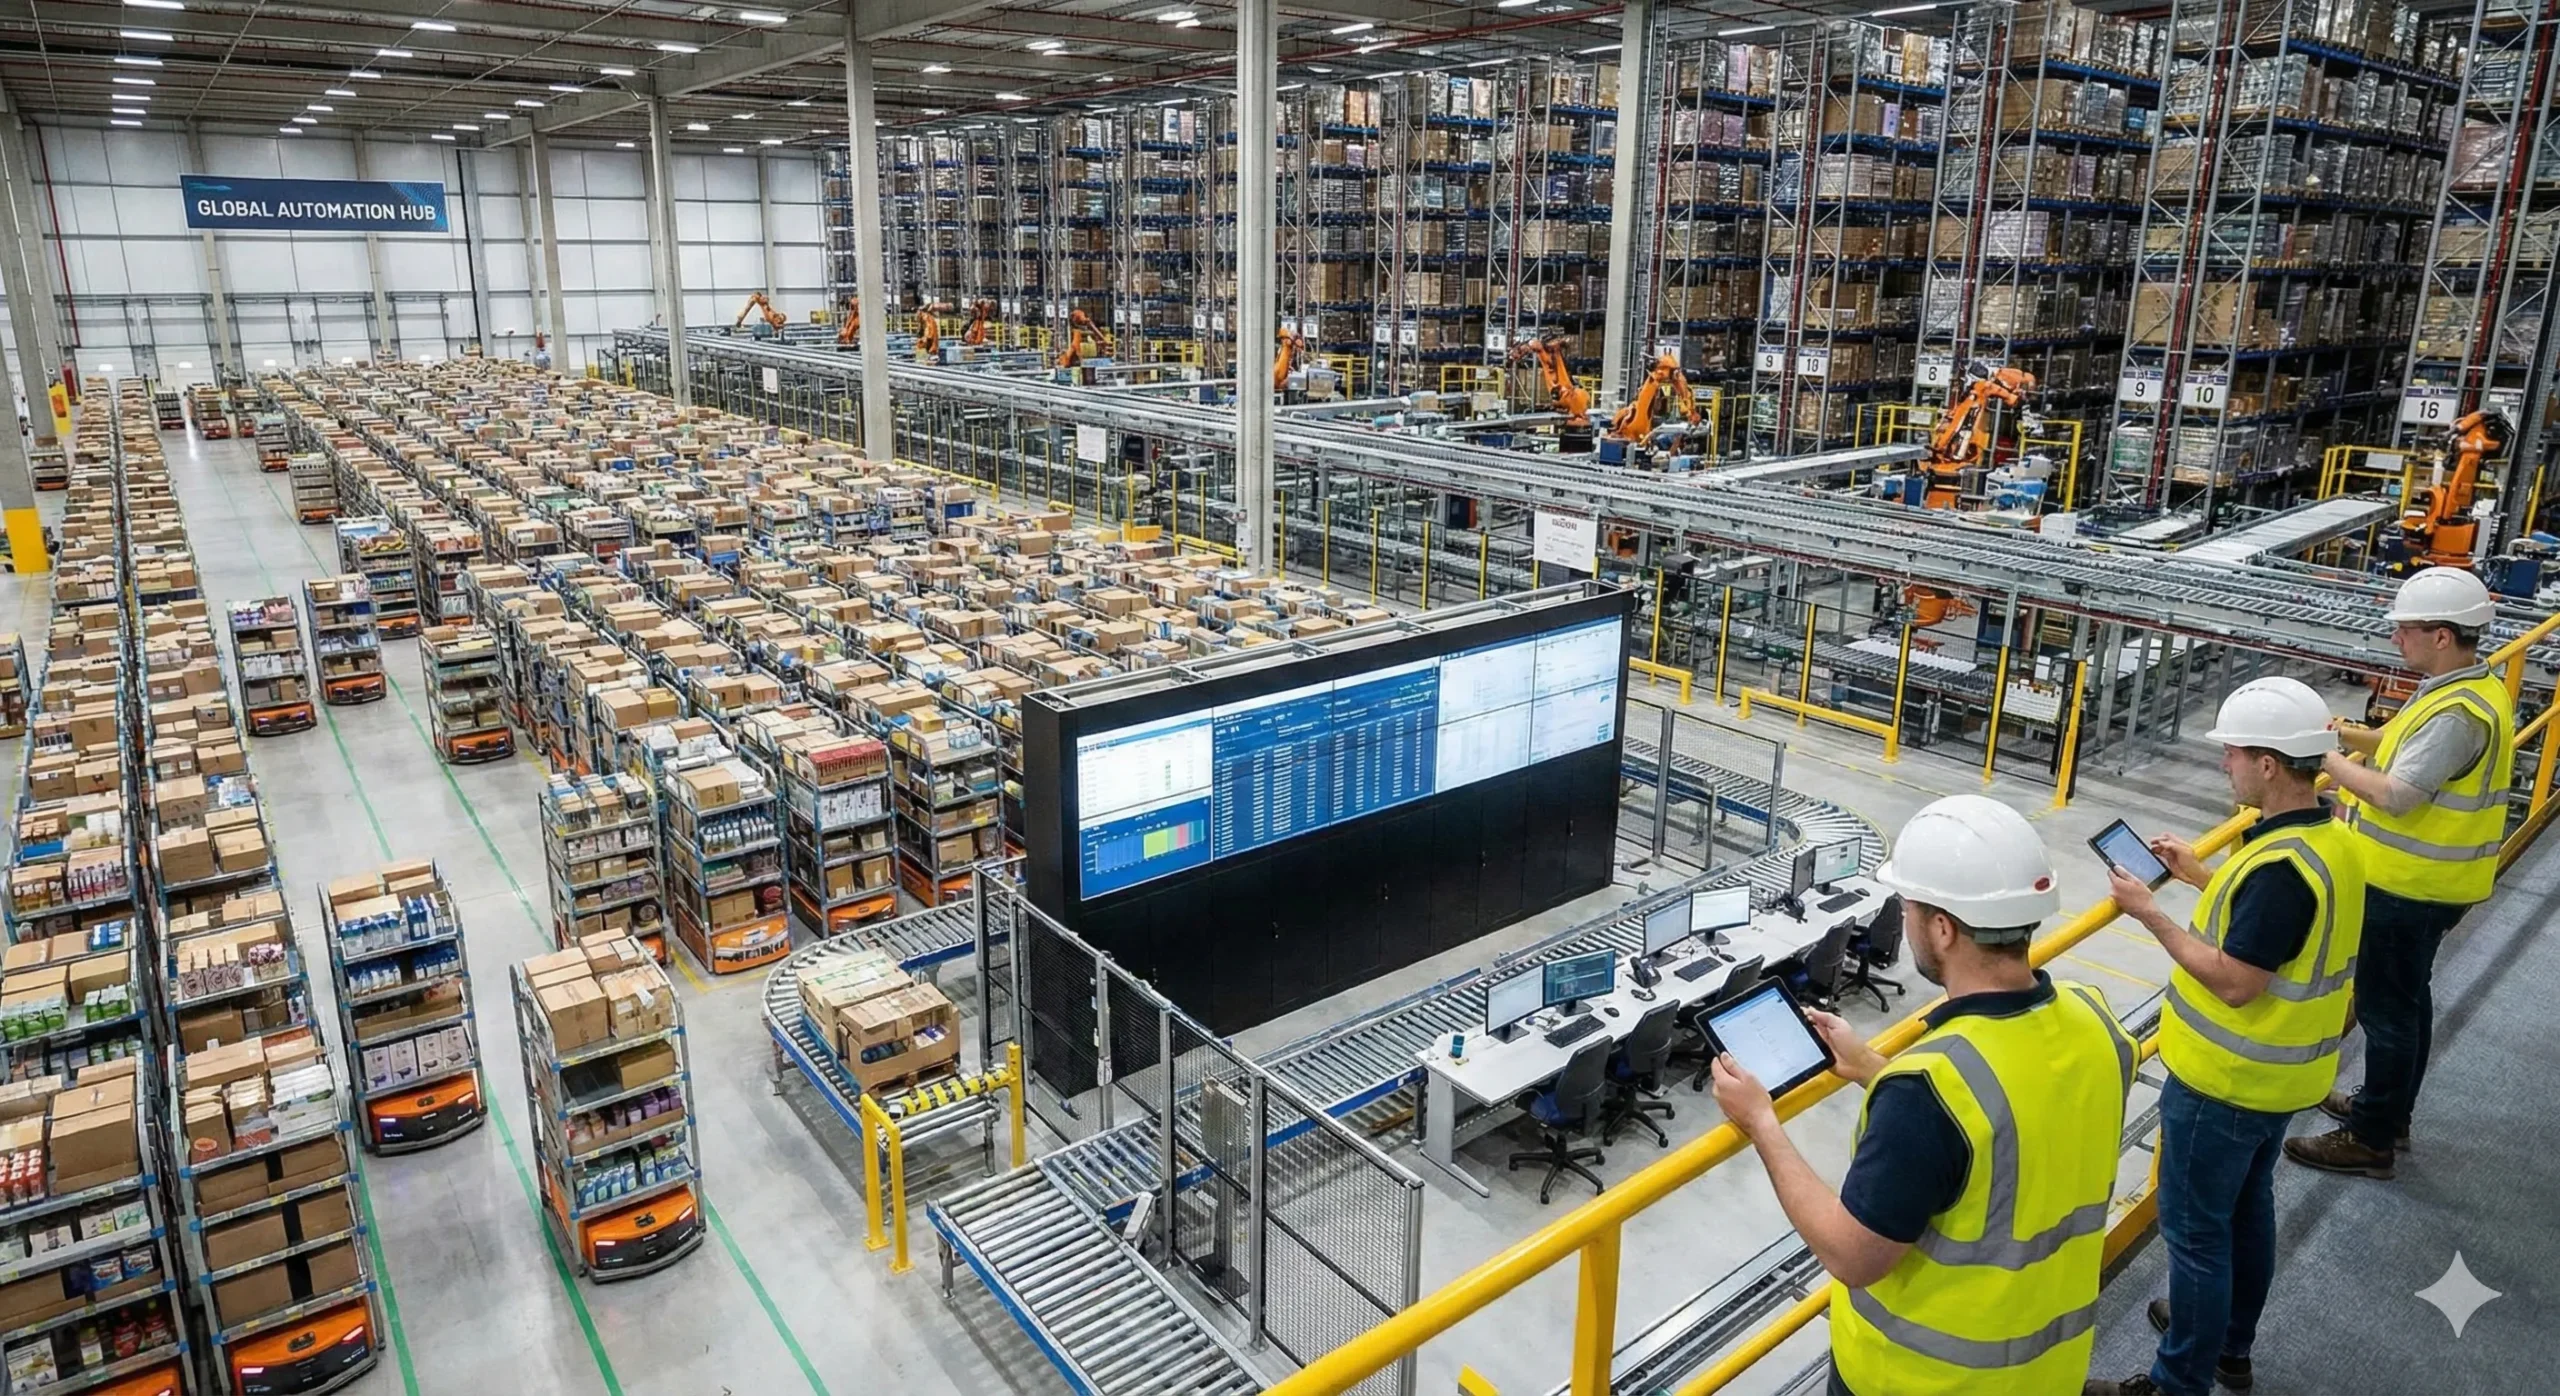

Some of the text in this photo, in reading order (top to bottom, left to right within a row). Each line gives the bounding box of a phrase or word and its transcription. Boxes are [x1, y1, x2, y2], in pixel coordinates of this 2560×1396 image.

[197, 199, 437, 221] GLOBAL AUTOMATION HUB
[1765, 354, 1774, 368] 9
[1928, 366, 1938, 381] 8
[2134, 381, 2146, 398] 9
[2194, 385, 2215, 404] 10
[2419, 400, 2440, 419] 16
